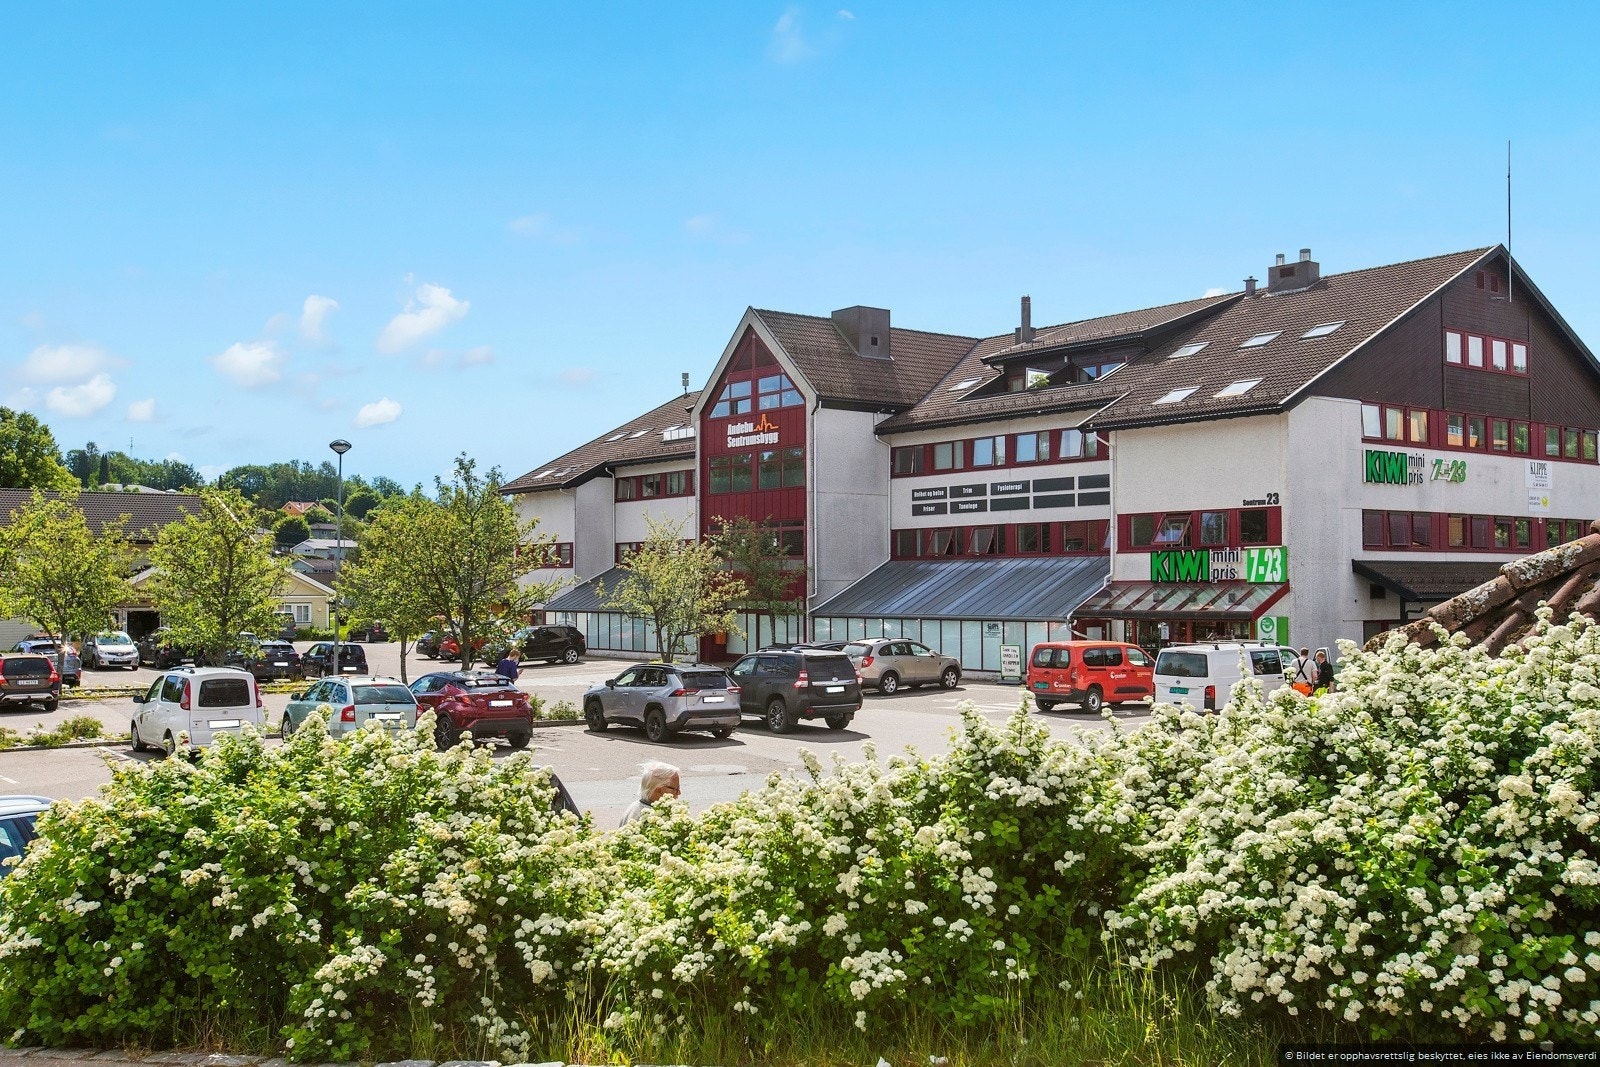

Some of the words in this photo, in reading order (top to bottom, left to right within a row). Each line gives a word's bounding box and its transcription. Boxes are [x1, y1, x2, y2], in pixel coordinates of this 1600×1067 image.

[727, 422, 754, 436] Andebu
[727, 432, 779, 448] Sentrumsbygg
[1364, 450, 1408, 485] KIWI
[1408, 453, 1425, 468] mini
[1530, 462, 1548, 475] KLIPPE
[1408, 469, 1424, 486] pris
[1266, 492, 1280, 505] 23
[1212, 547, 1241, 563] mini
[1151, 549, 1210, 583] KIWI
[1212, 564, 1238, 582] pris
[1249, 548, 1282, 583] 7-23
